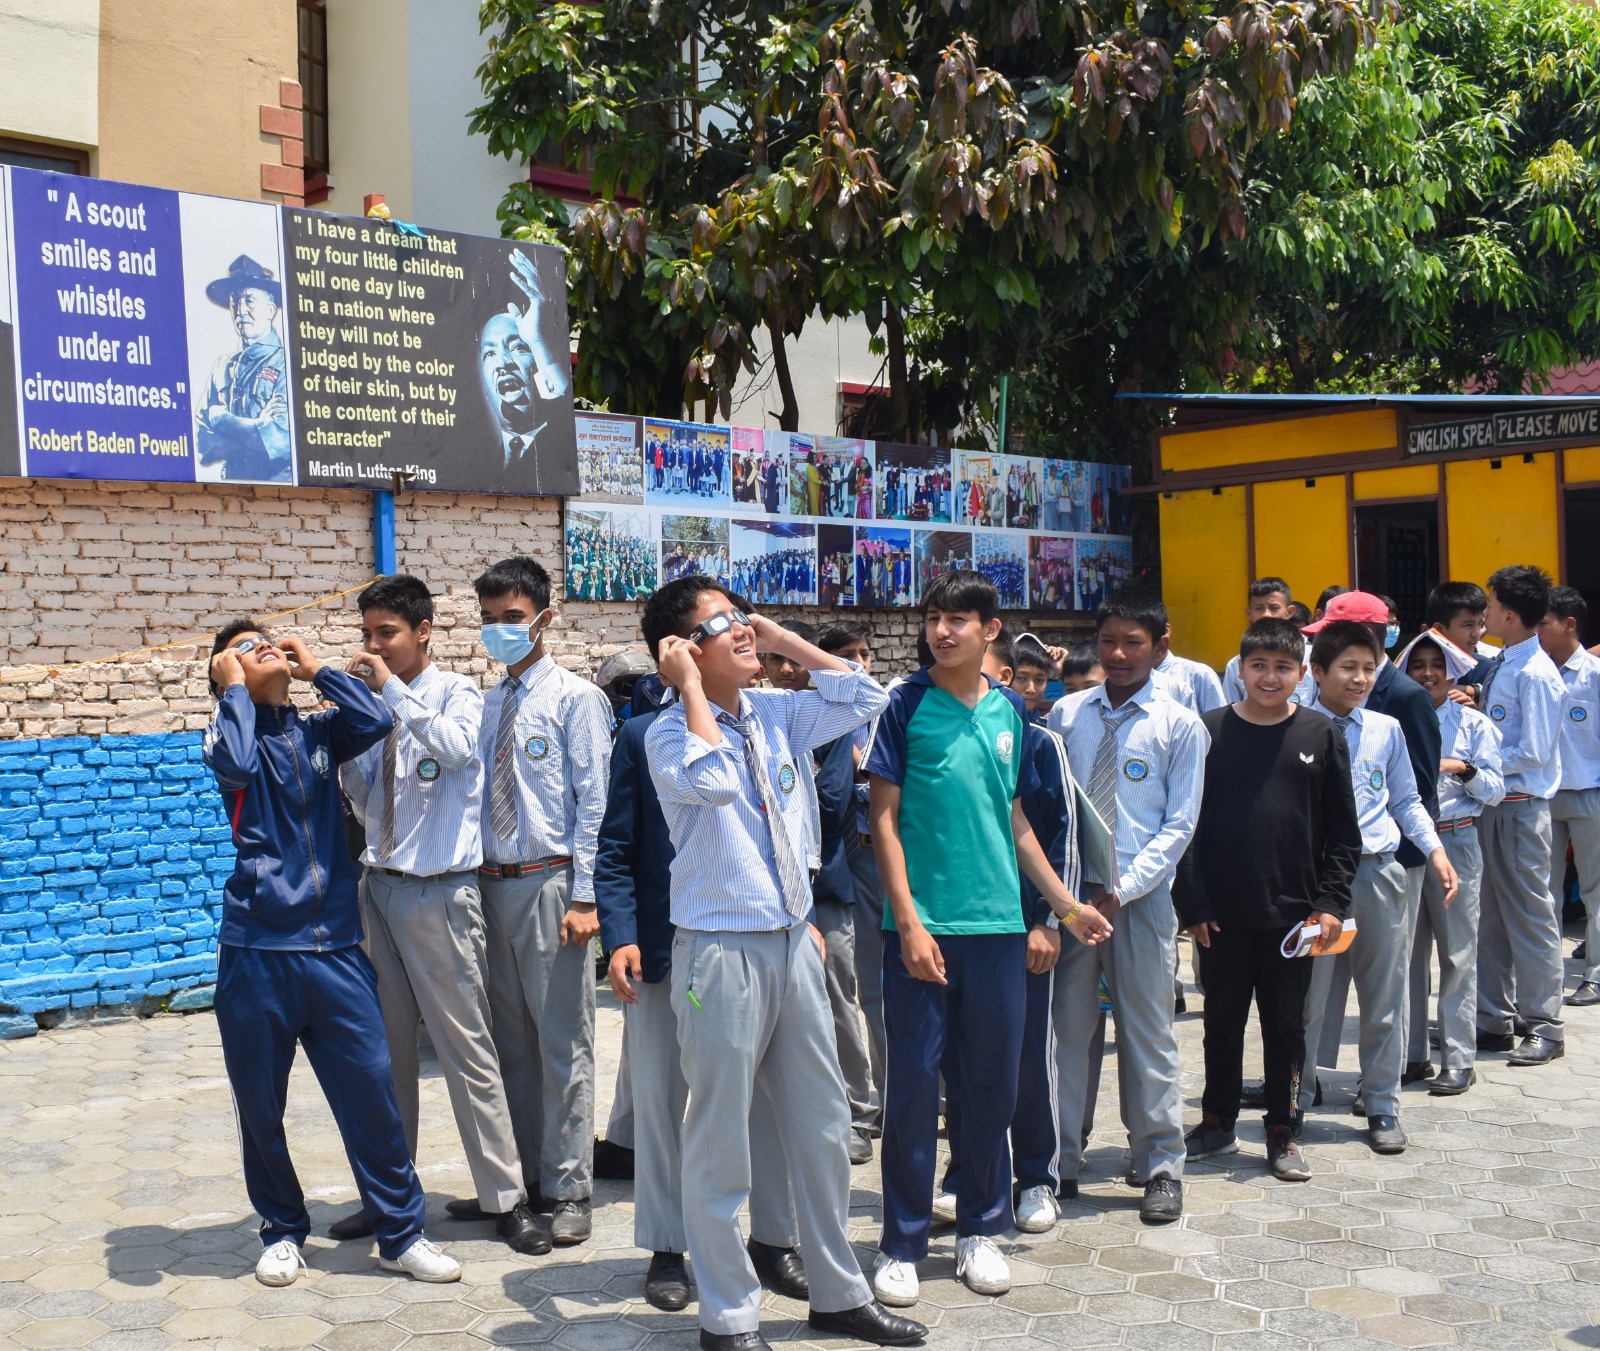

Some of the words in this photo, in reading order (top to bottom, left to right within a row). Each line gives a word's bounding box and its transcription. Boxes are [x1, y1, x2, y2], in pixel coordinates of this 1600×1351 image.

[65, 192, 82, 223] A
[87, 202, 147, 232] scout
[307, 217, 313, 236] I
[317, 220, 356, 241] have
[361, 229, 371, 243] a
[375, 228, 423, 250] dream
[427, 235, 457, 255] that
[41, 238, 111, 272] smiles
[118, 248, 156, 277] and
[295, 245, 320, 266] my
[325, 246, 359, 267] four
[363, 250, 398, 272] little
[402, 257, 464, 280] children
[296, 269, 325, 289] will
[331, 276, 360, 292] one
[365, 278, 393, 301] day
[398, 280, 425, 300] live
[57, 284, 146, 320] whistles
[298, 294, 314, 313] in
[319, 300, 329, 315] a
[334, 301, 384, 321] nation
[388, 305, 435, 326] where
[58, 331, 120, 363] under
[126, 336, 151, 365] all
[300, 321, 335, 345] they
[340, 325, 368, 344] will
[373, 330, 399, 348] not
[403, 331, 422, 349] be
[301, 347, 358, 371] judged
[362, 351, 382, 375] by
[386, 354, 411, 373] the
[416, 359, 455, 377] color
[24, 372, 186, 410] circumstances."
[303, 373, 320, 392] of
[324, 375, 362, 395] their
[367, 379, 405, 401] skin,
[409, 382, 435, 401] but
[439, 387, 457, 406] by
[305, 400, 331, 419] the
[336, 405, 397, 424] content
[401, 408, 417, 425] of
[421, 408, 456, 427] their
[1557, 409, 1598, 435] MOVE
[28, 428, 83, 453] Robert
[87, 431, 136, 454] Baden
[139, 433, 189, 457] Powell
[306, 427, 391, 448] character"
[1408, 426, 1459, 454] ENGLISH
[309, 460, 353, 478] Martin
[405, 464, 437, 484] King
